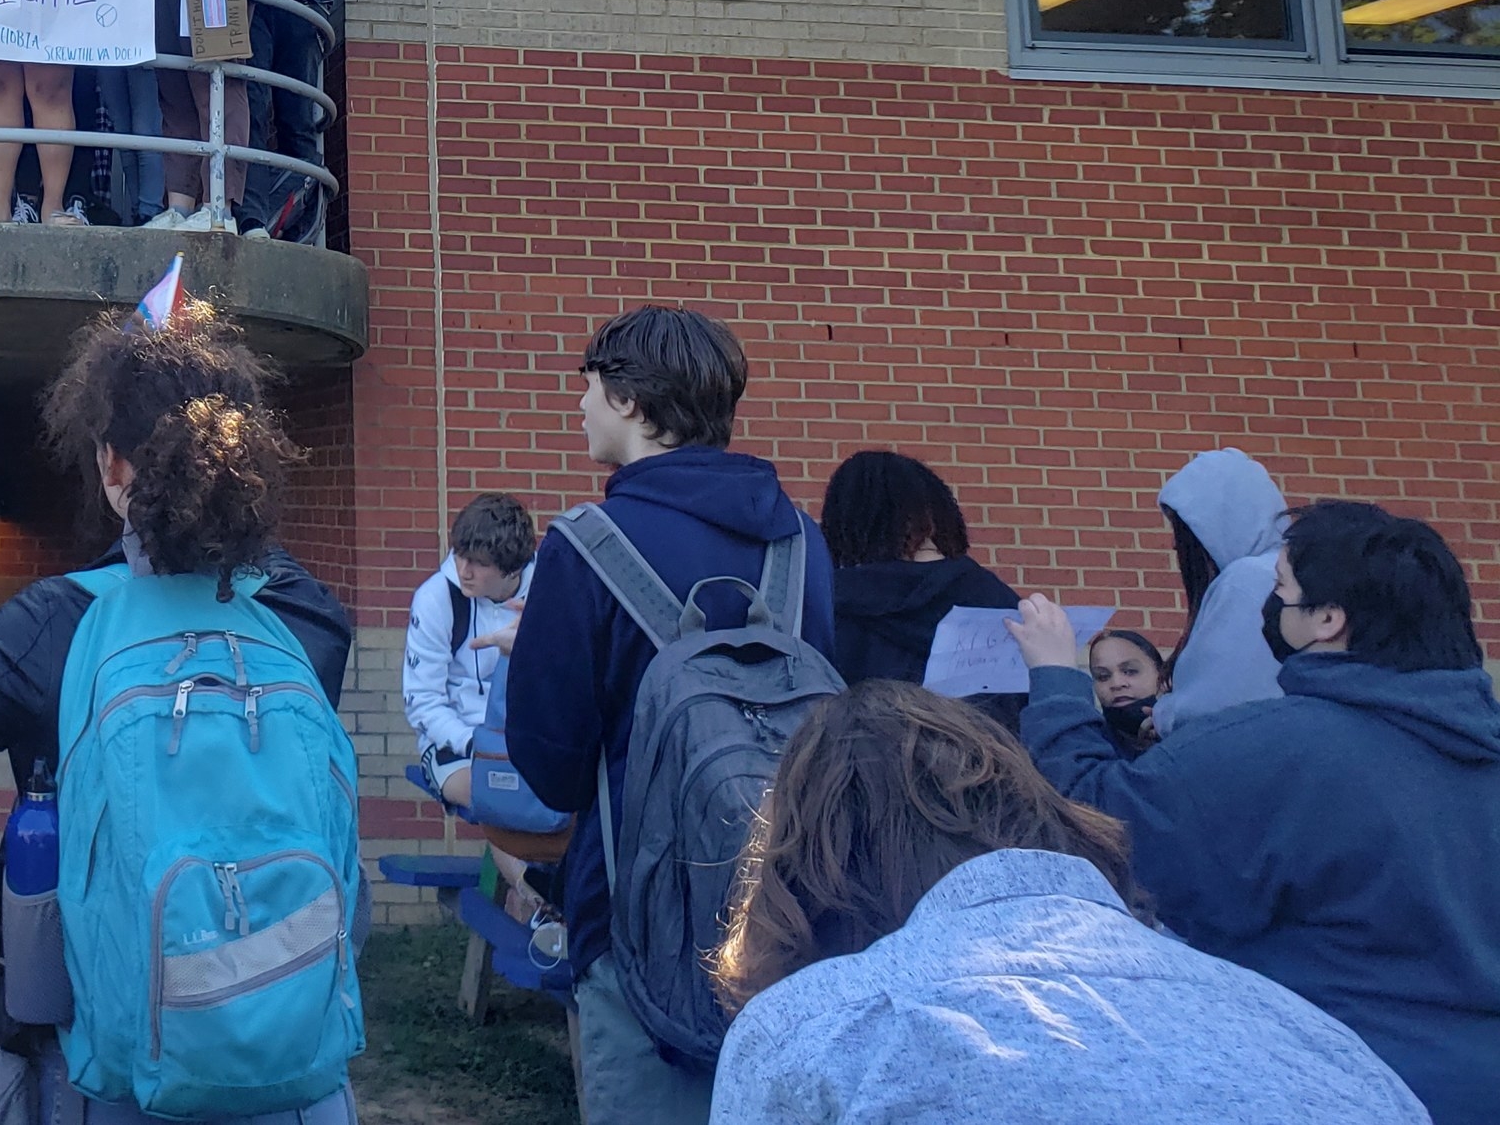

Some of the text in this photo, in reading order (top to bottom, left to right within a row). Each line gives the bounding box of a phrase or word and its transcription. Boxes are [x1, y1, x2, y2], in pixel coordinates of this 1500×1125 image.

[192, 17, 206, 55] DON'T
[228, 6, 244, 48] TRANS
[97, 48, 110, 60] VA
